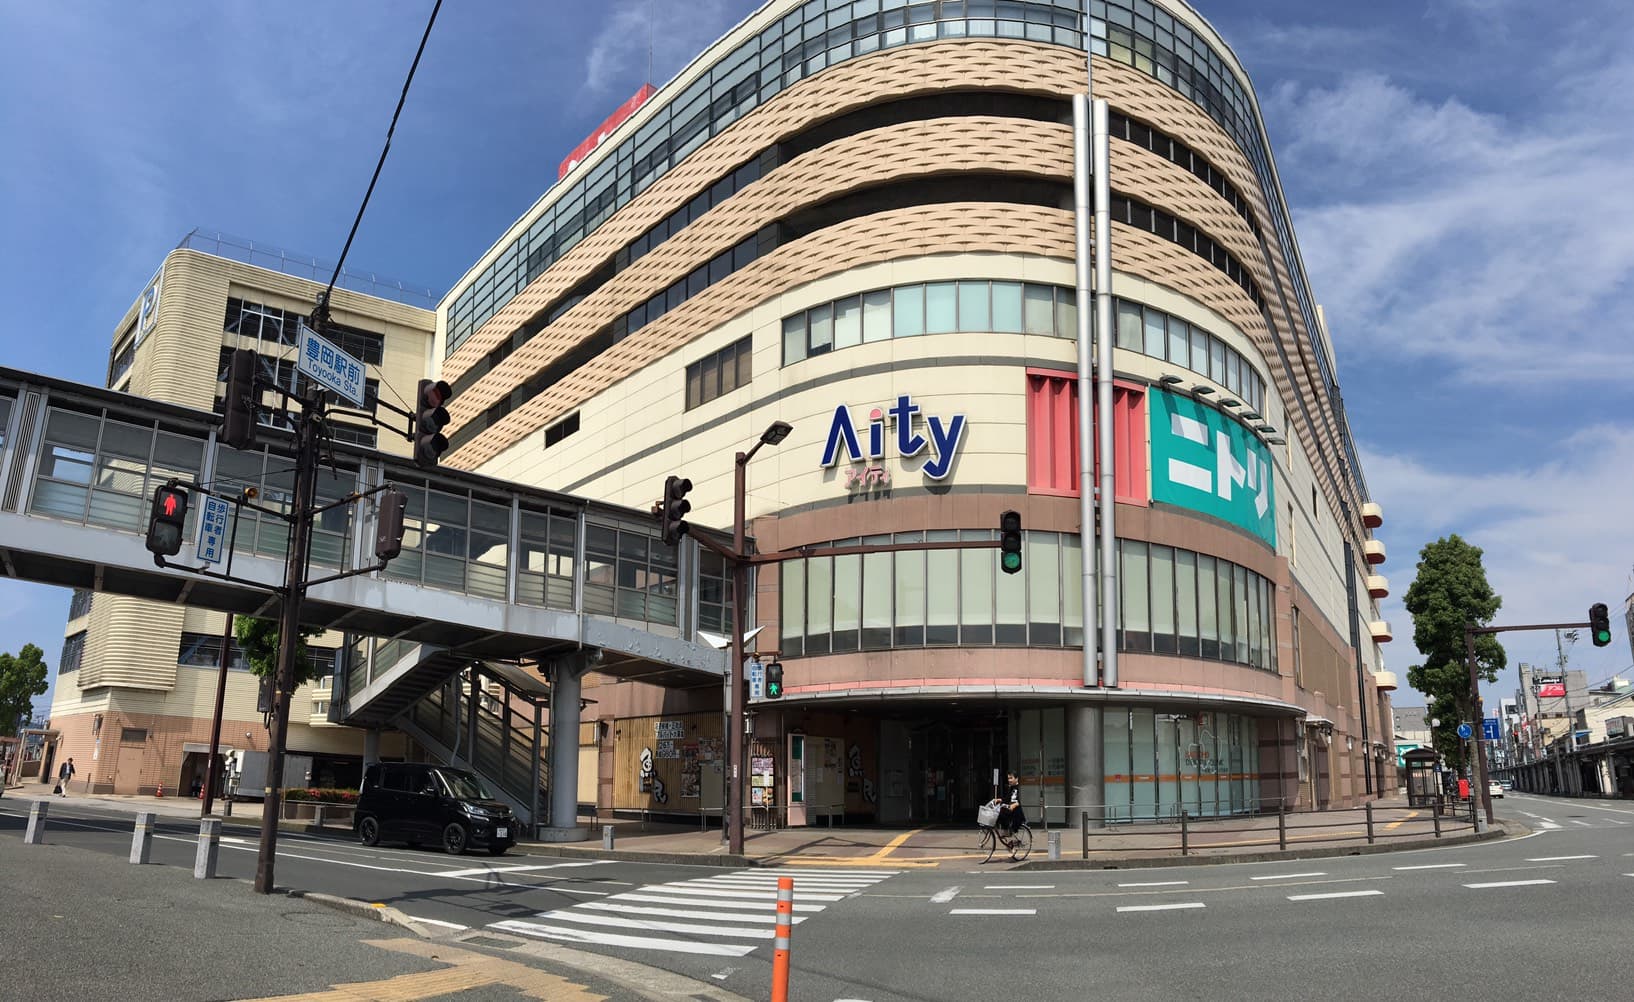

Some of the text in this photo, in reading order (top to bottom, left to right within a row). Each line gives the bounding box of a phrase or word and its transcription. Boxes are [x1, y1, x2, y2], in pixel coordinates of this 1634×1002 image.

[306, 337, 360, 385] 豊岡駅前
[308, 358, 359, 397] Toyooka Sta.
[820, 393, 967, 480] Aity
[844, 466, 890, 489] アイティ
[1168, 413, 1269, 520] ニトリ
